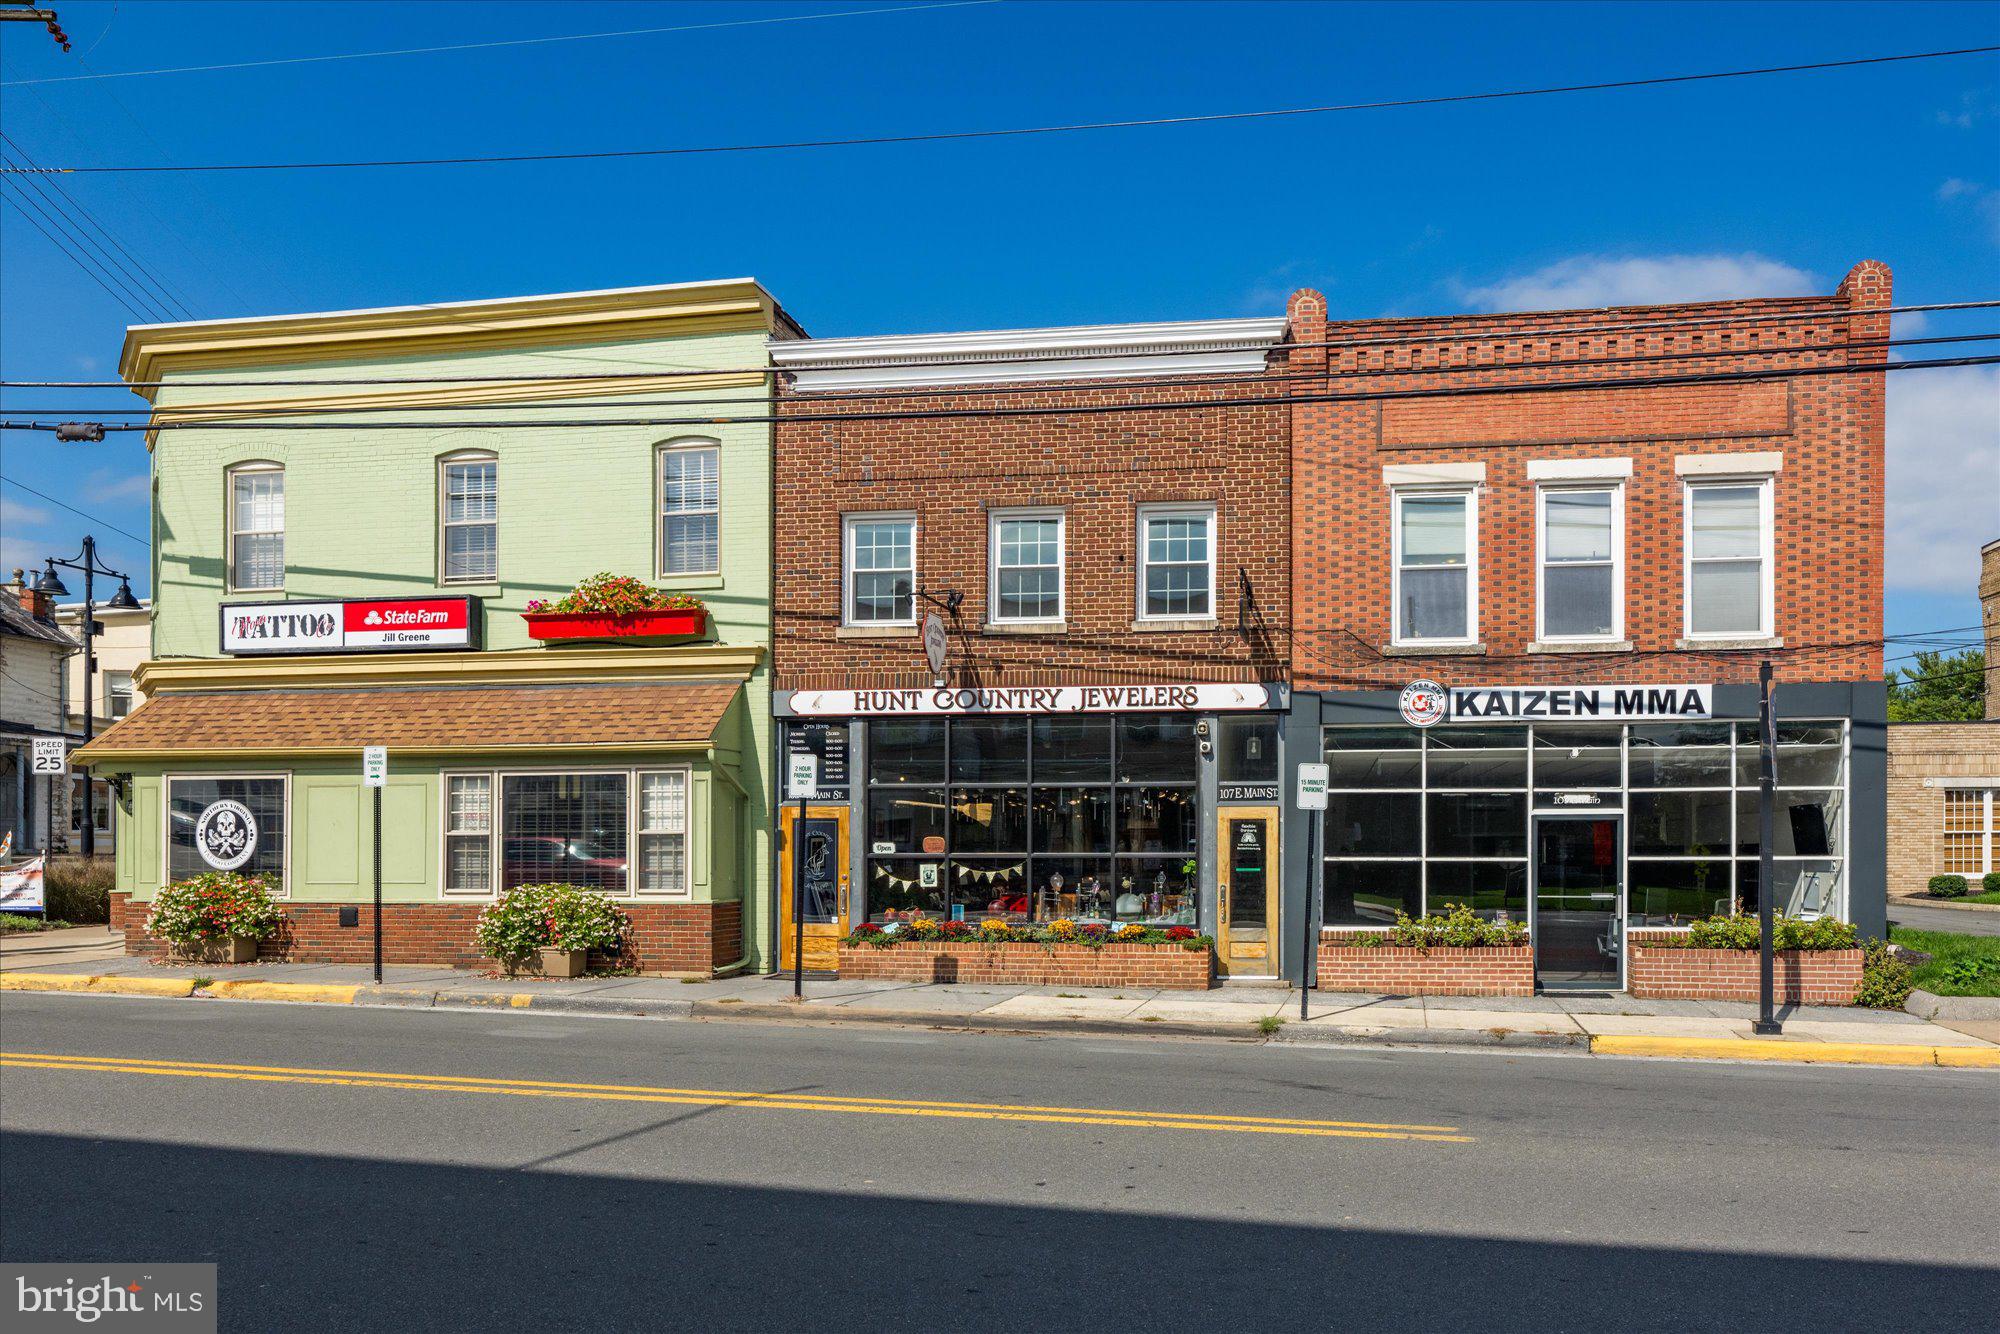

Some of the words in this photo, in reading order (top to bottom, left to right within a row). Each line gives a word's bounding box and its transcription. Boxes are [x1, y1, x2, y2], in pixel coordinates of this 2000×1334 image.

[234, 613, 335, 639] TATTOO
[382, 632, 396, 642] Jill
[398, 632, 430, 642] Greene
[853, 691, 923, 711] HUNT
[932, 689, 1063, 713] COUNTRY
[1071, 686, 1199, 713] JEWELERS
[1402, 683, 1429, 702] KAIZEN
[1430, 685, 1443, 700] MMA
[1456, 690, 1599, 716] KAIZEN
[1614, 689, 1706, 715] MMA
[35, 757, 62, 770] 25
[1219, 789, 1235, 799] 107
[1244, 788, 1266, 799] MAIN
[201, 803, 228, 824] NORTHERN
[230, 803, 252, 825] VIRGINIA
[877, 844, 892, 852] Open
